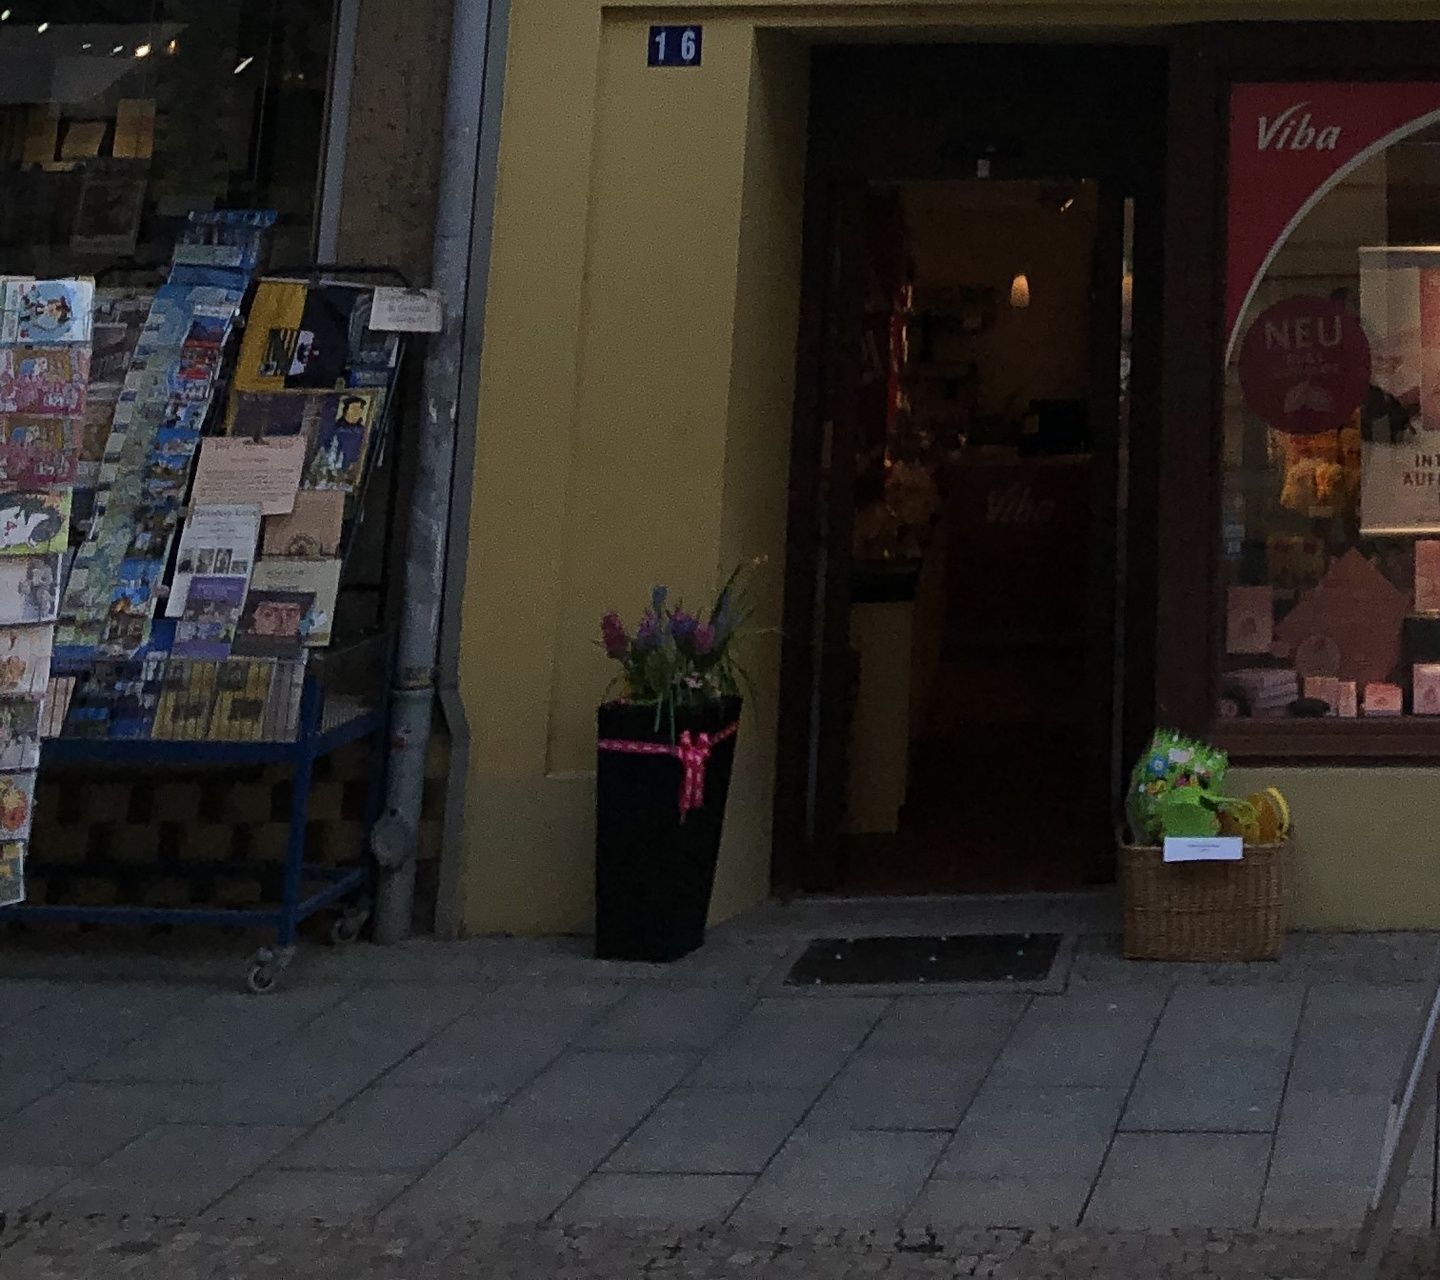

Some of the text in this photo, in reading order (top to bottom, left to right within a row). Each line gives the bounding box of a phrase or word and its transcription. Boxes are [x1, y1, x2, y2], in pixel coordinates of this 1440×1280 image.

[654, 30, 697, 61] 16
[1257, 100, 1343, 152] Viba
[1263, 314, 1344, 351] NEU
